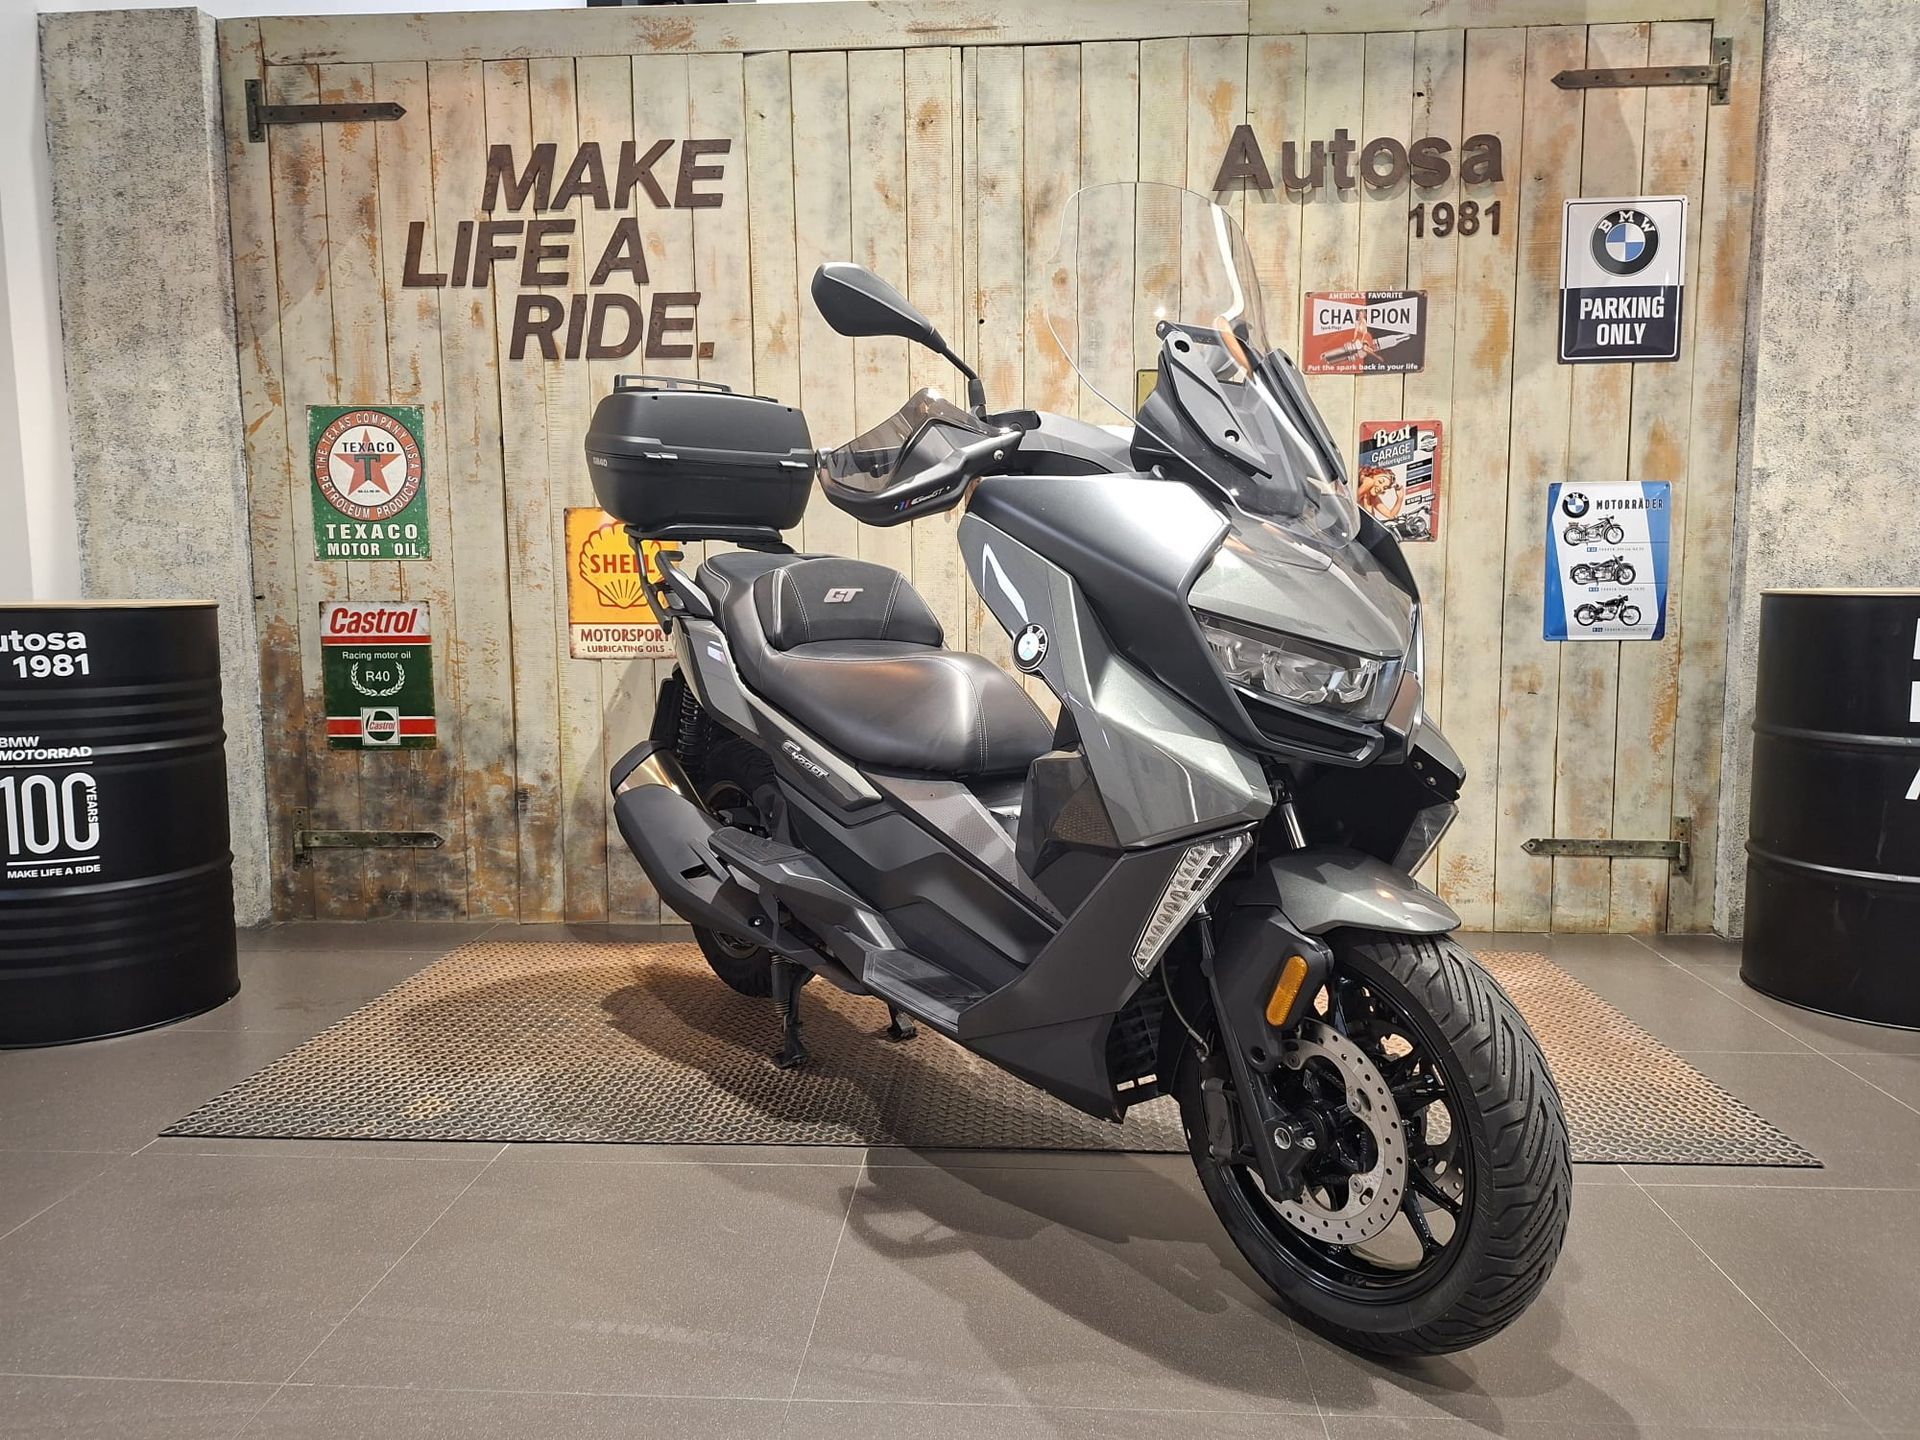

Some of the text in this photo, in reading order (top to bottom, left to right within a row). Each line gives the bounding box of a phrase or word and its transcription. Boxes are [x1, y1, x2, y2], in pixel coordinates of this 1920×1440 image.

[1212, 124, 1504, 191] Autosa
[482, 139, 731, 211] MAKE
[1408, 200, 1501, 238] 1981
[1598, 210, 1656, 234] BMW
[403, 217, 649, 287] LIFE A
[1367, 291, 1403, 299] FAVORITE
[1580, 296, 1665, 320] PARKING
[509, 292, 715, 360] RIDE.
[1596, 323, 1647, 346] ONLY
[1307, 361, 1419, 373] Put the spark back in your life
[316, 449, 328, 471] THE
[324, 416, 353, 446] TEXAS
[355, 413, 409, 439] COMPANY
[1374, 424, 1412, 448] Best
[342, 442, 395, 453] TEXACO
[1371, 443, 1411, 463] GARAGE
[318, 475, 418, 518] PETROLEUM PRODUCTS
[1596, 498, 1664, 510] MOTORRÄDER
[326, 524, 418, 540] TEXACO
[327, 542, 419, 556] MOTOR OIL
[823, 587, 864, 603] GT
[330, 607, 418, 635] Castrol
[342, 651, 411, 661] Racing motor oil
[587, 645, 665, 653] LUBRICATING OILS
[12, 653, 90, 679] 1981
[365, 670, 390, 682] R40
[369, 721, 396, 730] Castrol
[0, 736, 40, 748] BMW
[0, 746, 93, 761] MOTORRAD
[0, 772, 100, 855] 100
[86, 786, 98, 823] YEARS
[7, 864, 101, 879] MAKE LIFE A RIDE
